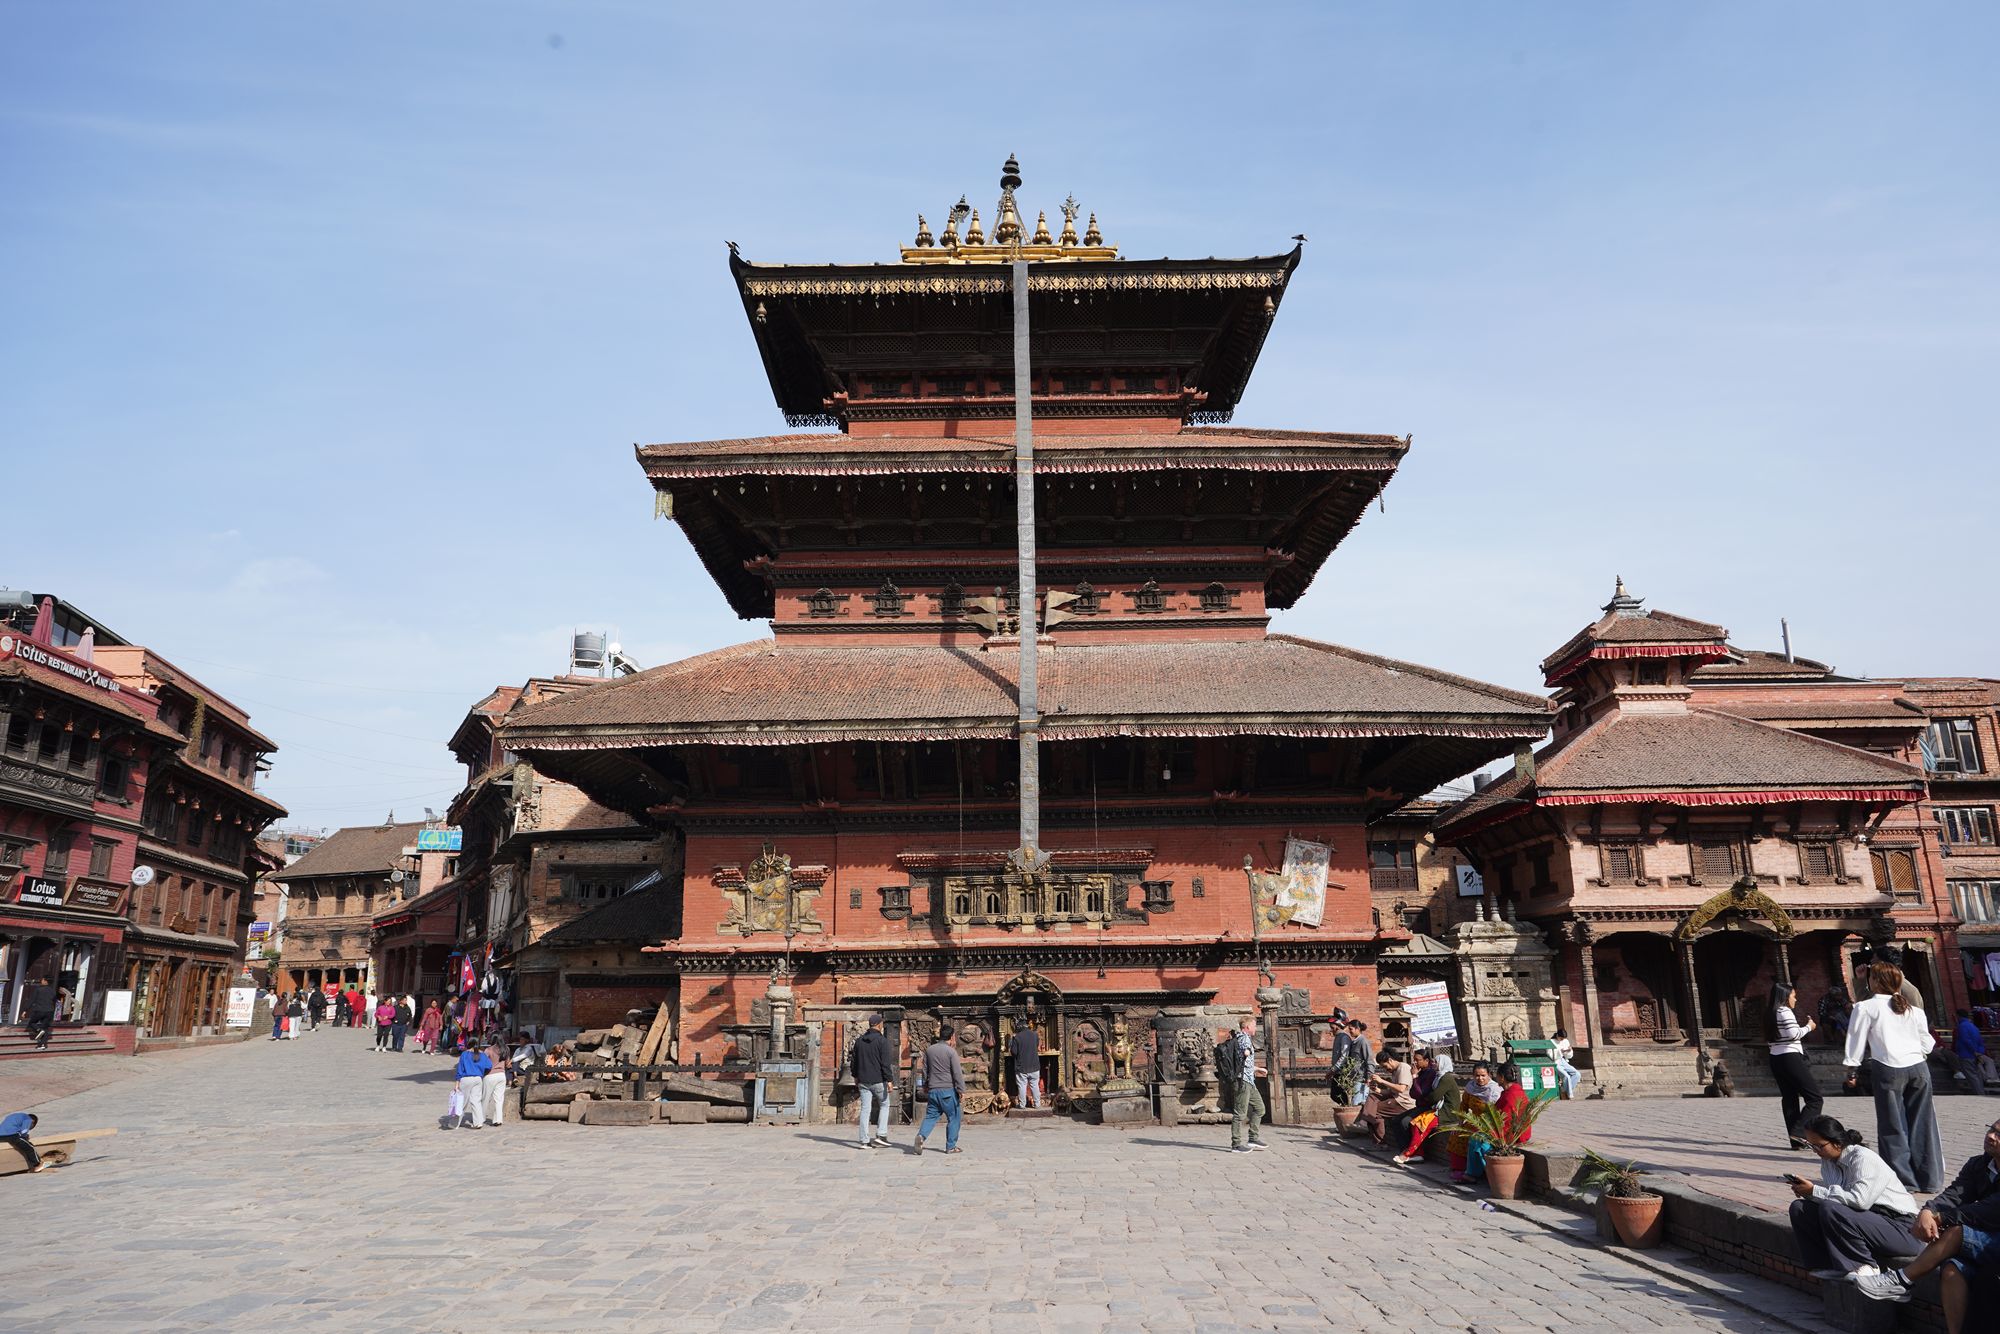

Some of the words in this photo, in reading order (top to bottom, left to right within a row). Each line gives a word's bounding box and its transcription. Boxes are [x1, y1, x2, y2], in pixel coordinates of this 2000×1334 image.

[15, 639, 48, 664] Lotus
[48, 656, 88, 680] RESTAURANT
[95, 676, 109, 689] AND
[108, 681, 120, 693] BAR
[31, 879, 57, 896] Lotus
[227, 1002, 250, 1012] unny
